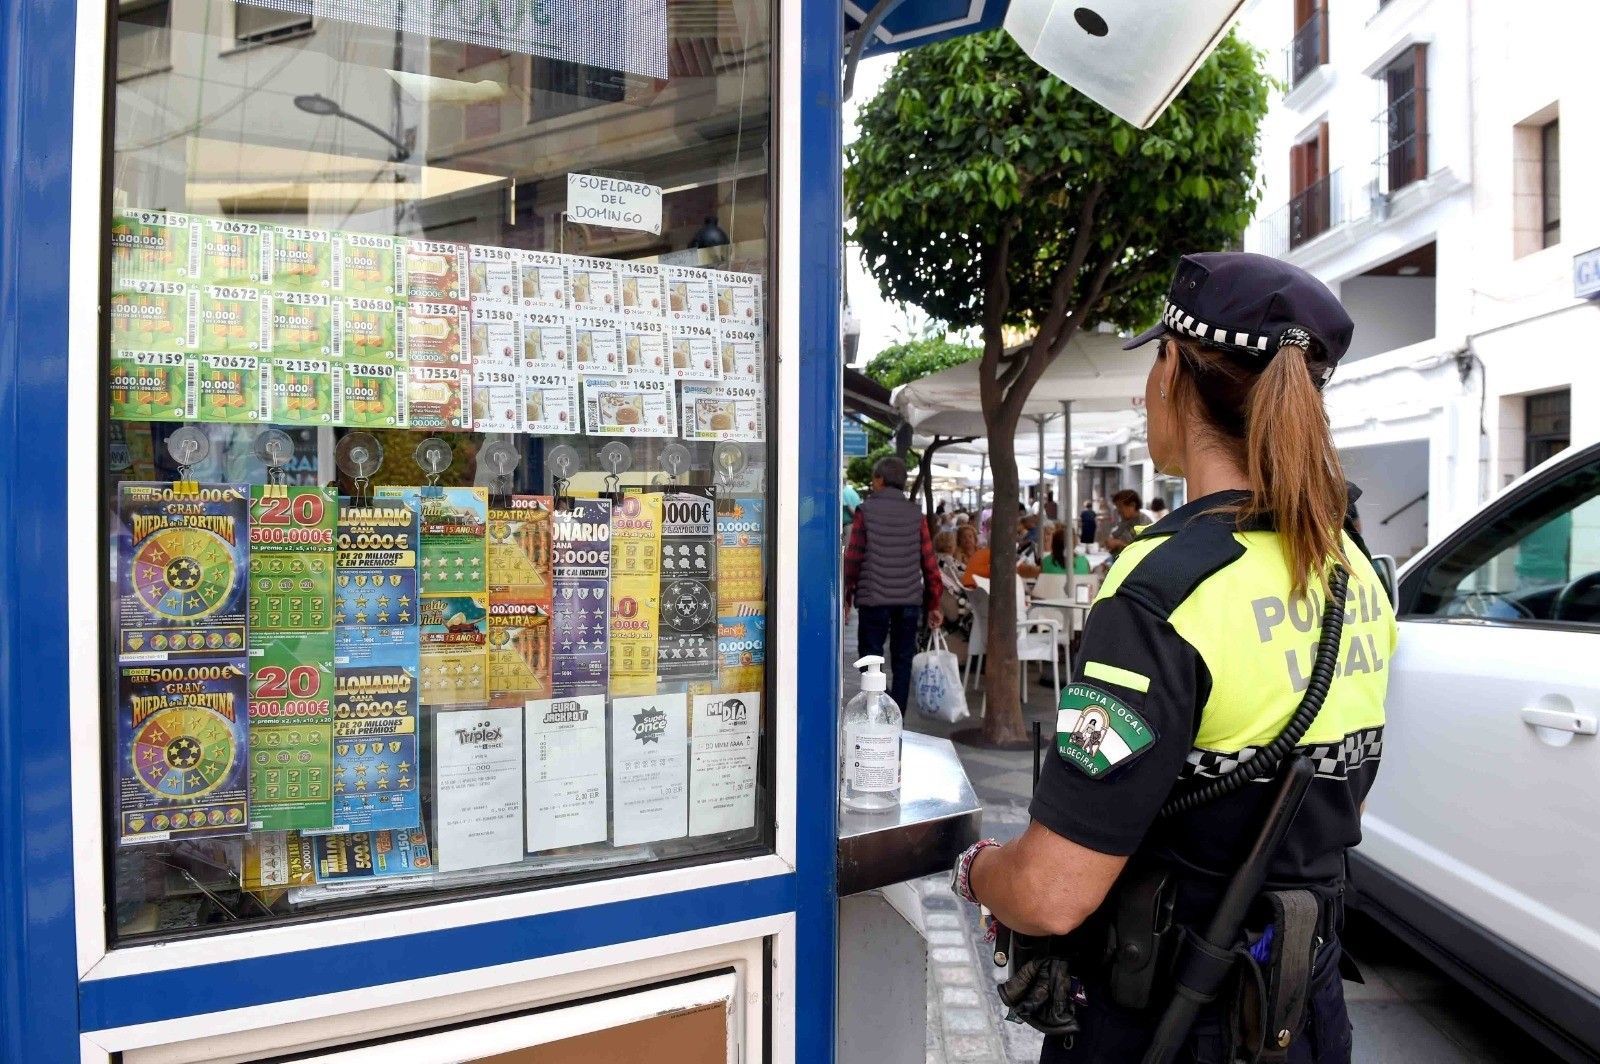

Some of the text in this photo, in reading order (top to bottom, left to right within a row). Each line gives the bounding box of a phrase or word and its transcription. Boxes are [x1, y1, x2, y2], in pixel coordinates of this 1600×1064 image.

[580, 176, 651, 197] SUELDAZO
[602, 195, 626, 205] DEL
[576, 205, 642, 223] DOMINGO
[216, 221, 258, 234] 70672
[287, 229, 327, 241] 21391
[352, 236, 391, 247] 30680
[418, 242, 454, 253] 17554
[475, 249, 511, 259] 51380
[527, 254, 563, 266] 92471
[579, 260, 612, 270] 71592
[628, 264, 659, 274] 14503
[677, 269, 708, 279] 37964
[724, 275, 753, 284] 65049
[140, 281, 184, 293] 97159
[213, 287, 257, 300] 70672
[287, 293, 327, 305] 21391
[352, 299, 392, 311] 30680
[420, 304, 456, 315] 17554
[477, 309, 513, 320] 51380
[530, 314, 565, 324] 92471
[582, 318, 615, 328] 71592
[631, 321, 662, 332] 14503
[680, 326, 712, 335] 37964
[726, 331, 755, 340] 65049
[137, 353, 182, 364] 97159
[212, 357, 256, 368] 70672
[287, 361, 327, 372] 21391
[353, 365, 392, 376] 30680
[420, 369, 457, 379] 17554
[478, 372, 515, 382] 51380
[532, 375, 567, 385] 92471
[634, 381, 665, 390] 14503
[726, 388, 756, 397] 65049
[167, 503, 201, 514] GRAN
[488, 510, 530, 519] OPATRA
[132, 514, 168, 547] RUEDA
[183, 515, 236, 547] FORTUNA
[250, 528, 333, 544] 500.000€
[338, 534, 409, 550] 0.000€
[365, 552, 403, 560] MILLONES
[489, 615, 531, 626] OPATRA
[150, 666, 232, 682] 500.000€
[166, 683, 201, 693] GRAN
[132, 695, 168, 729] RUEDA
[182, 692, 236, 723] FORTUNA
[250, 700, 329, 717] 500.000€
[551, 701, 580, 711] EURO
[707, 701, 746, 722] MI DÍA
[1068, 687, 1143, 735] POLICIA LOCAL
[543, 710, 588, 723] JACKPOT
[643, 714, 667, 724] Super
[364, 719, 403, 728] MILLONES
[635, 720, 667, 734] Once
[358, 726, 397, 734] PREMIOS!
[455, 727, 502, 745] Triplex
[1059, 746, 1099, 774] ALGECIRAS
